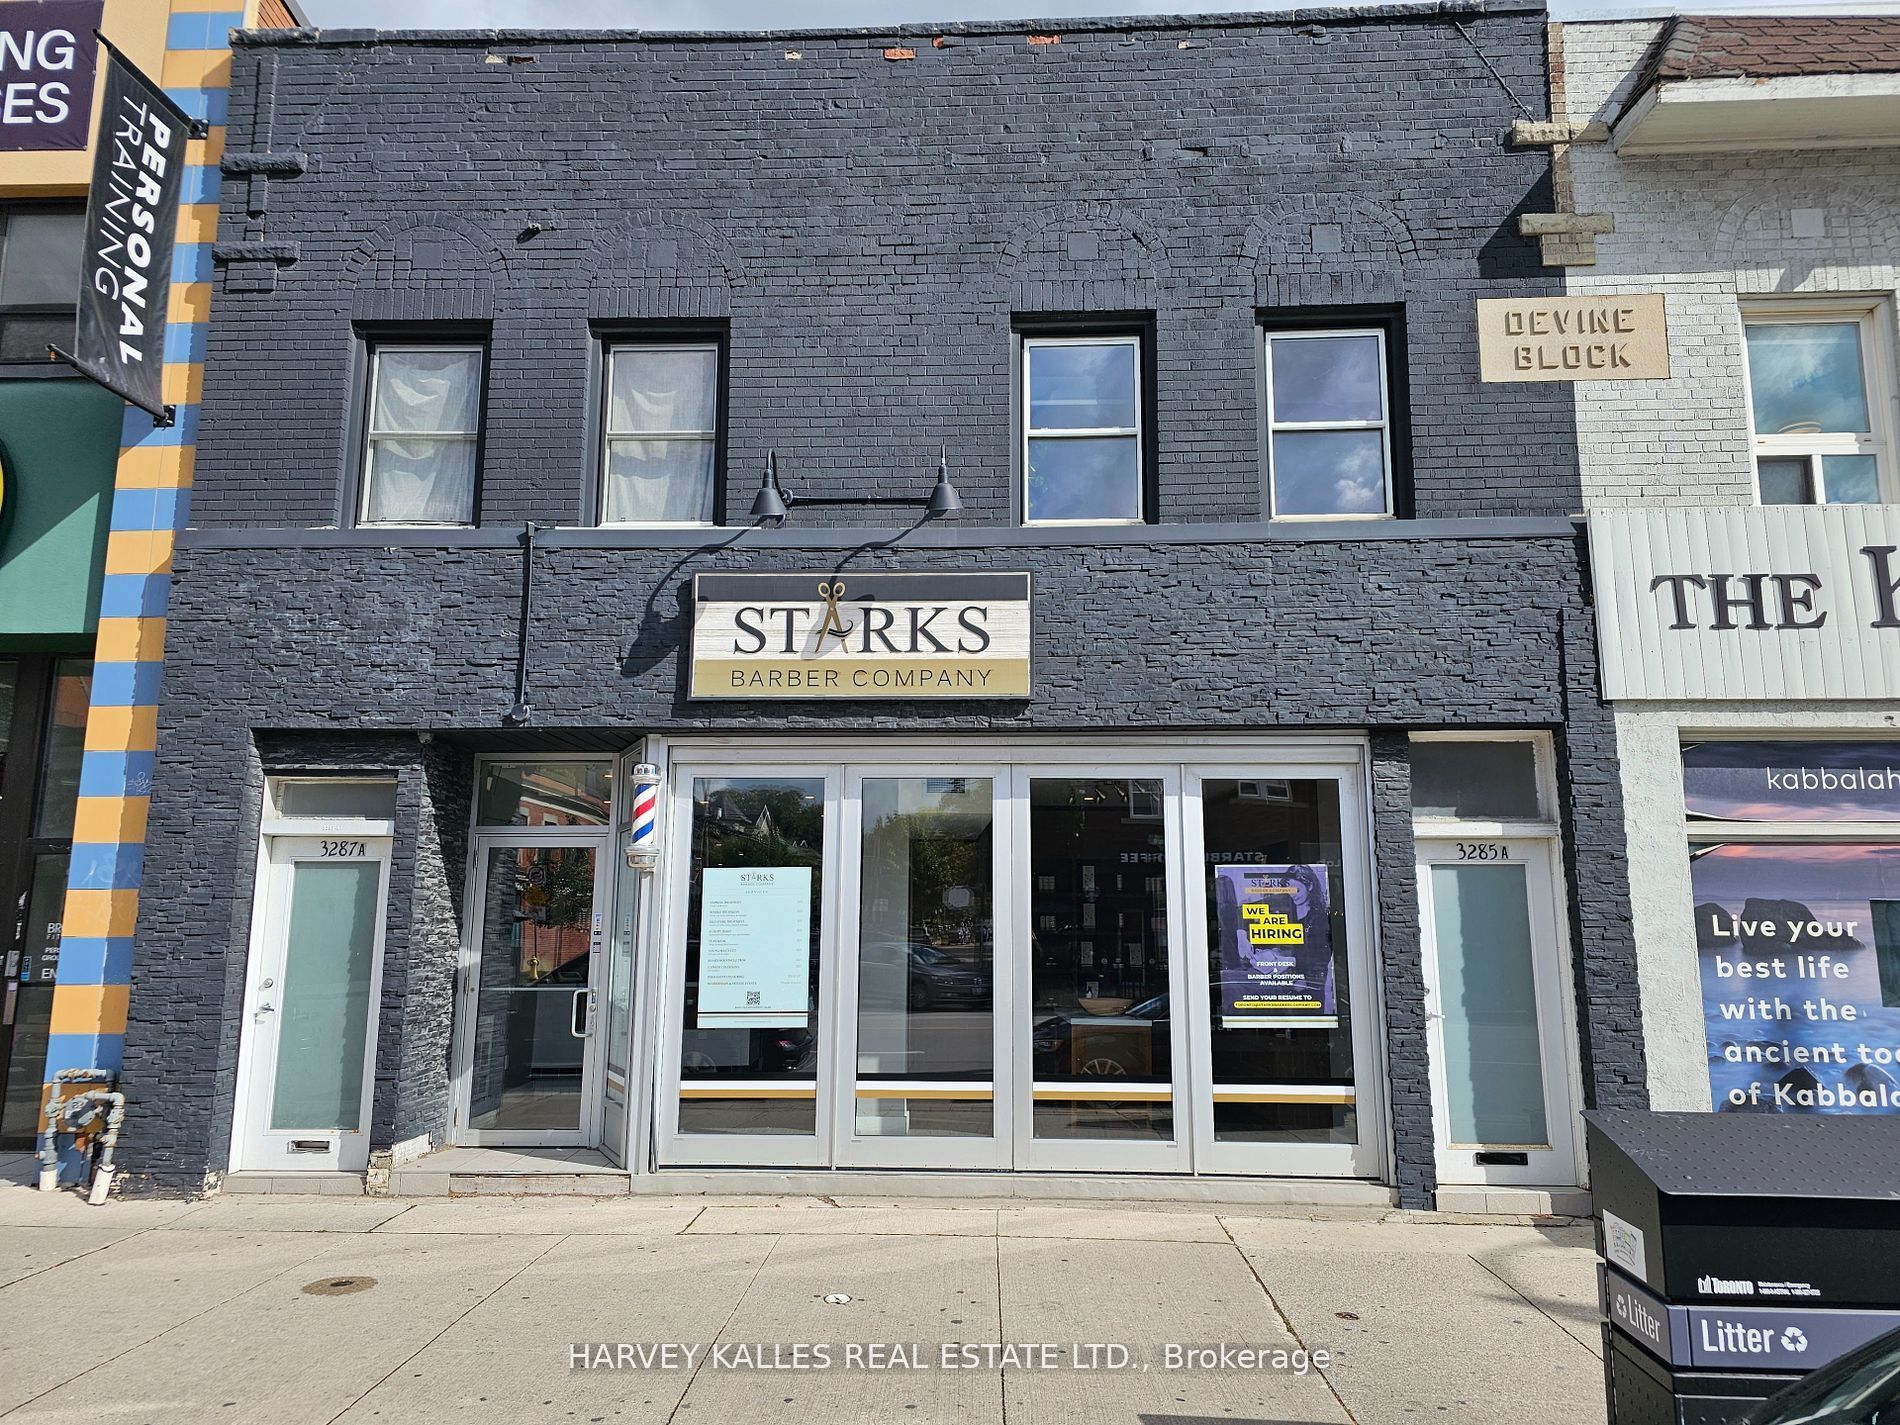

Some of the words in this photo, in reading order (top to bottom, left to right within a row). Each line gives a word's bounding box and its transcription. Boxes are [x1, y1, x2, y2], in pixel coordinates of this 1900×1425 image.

[0, 82, 71, 124] ES
[95, 95, 147, 300] TRAINING
[119, 112, 171, 365] PERSONAL
[1504, 308, 1635, 336] DEVINE
[1514, 342, 1631, 370] BLOCK
[1649, 573, 1828, 631] THE
[733, 602, 992, 655] STARKS
[731, 669, 840, 688] BARBER
[852, 669, 992, 688] COMPANY
[1766, 766, 1900, 790] kabbalah
[320, 840, 366, 857] 3287A
[1246, 907, 1265, 915] WE
[1263, 917, 1286, 925] ARE
[1251, 928, 1302, 939] HIRING
[1711, 914, 1776, 937] Live
[1787, 920, 1858, 943] your
[1715, 955, 1787, 979] best
[1798, 955, 1849, 979] life
[1719, 997, 1792, 1021] with
[1803, 997, 1857, 1021] the
[1724, 1039, 1847, 1064] ancient
[1728, 1081, 1761, 1106] of
[1711, 1277, 1755, 1295] TORONTO
[1627, 1294, 1661, 1343] Litter
[1701, 1319, 1775, 1353] Litter
